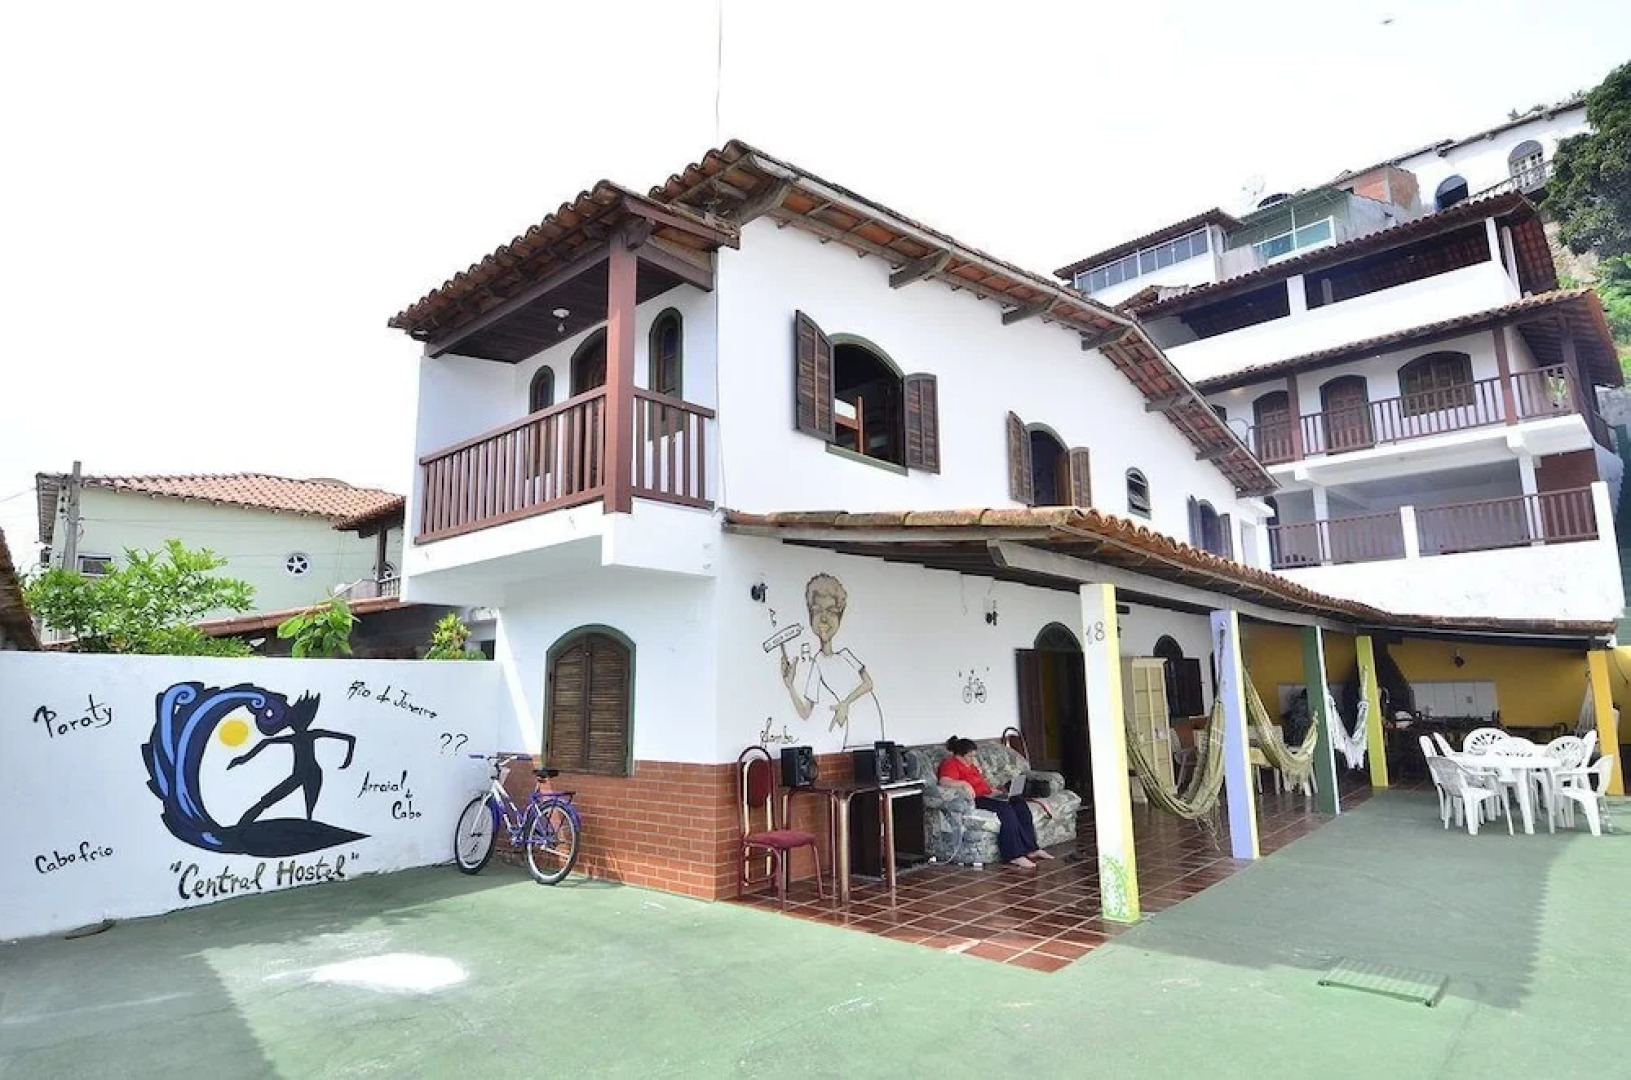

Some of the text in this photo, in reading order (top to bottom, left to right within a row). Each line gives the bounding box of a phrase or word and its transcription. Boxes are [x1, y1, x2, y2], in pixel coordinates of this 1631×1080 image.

[347, 679, 371, 700] Rio
[32, 693, 113, 738] Paraty
[392, 801, 422, 819] Cabo
